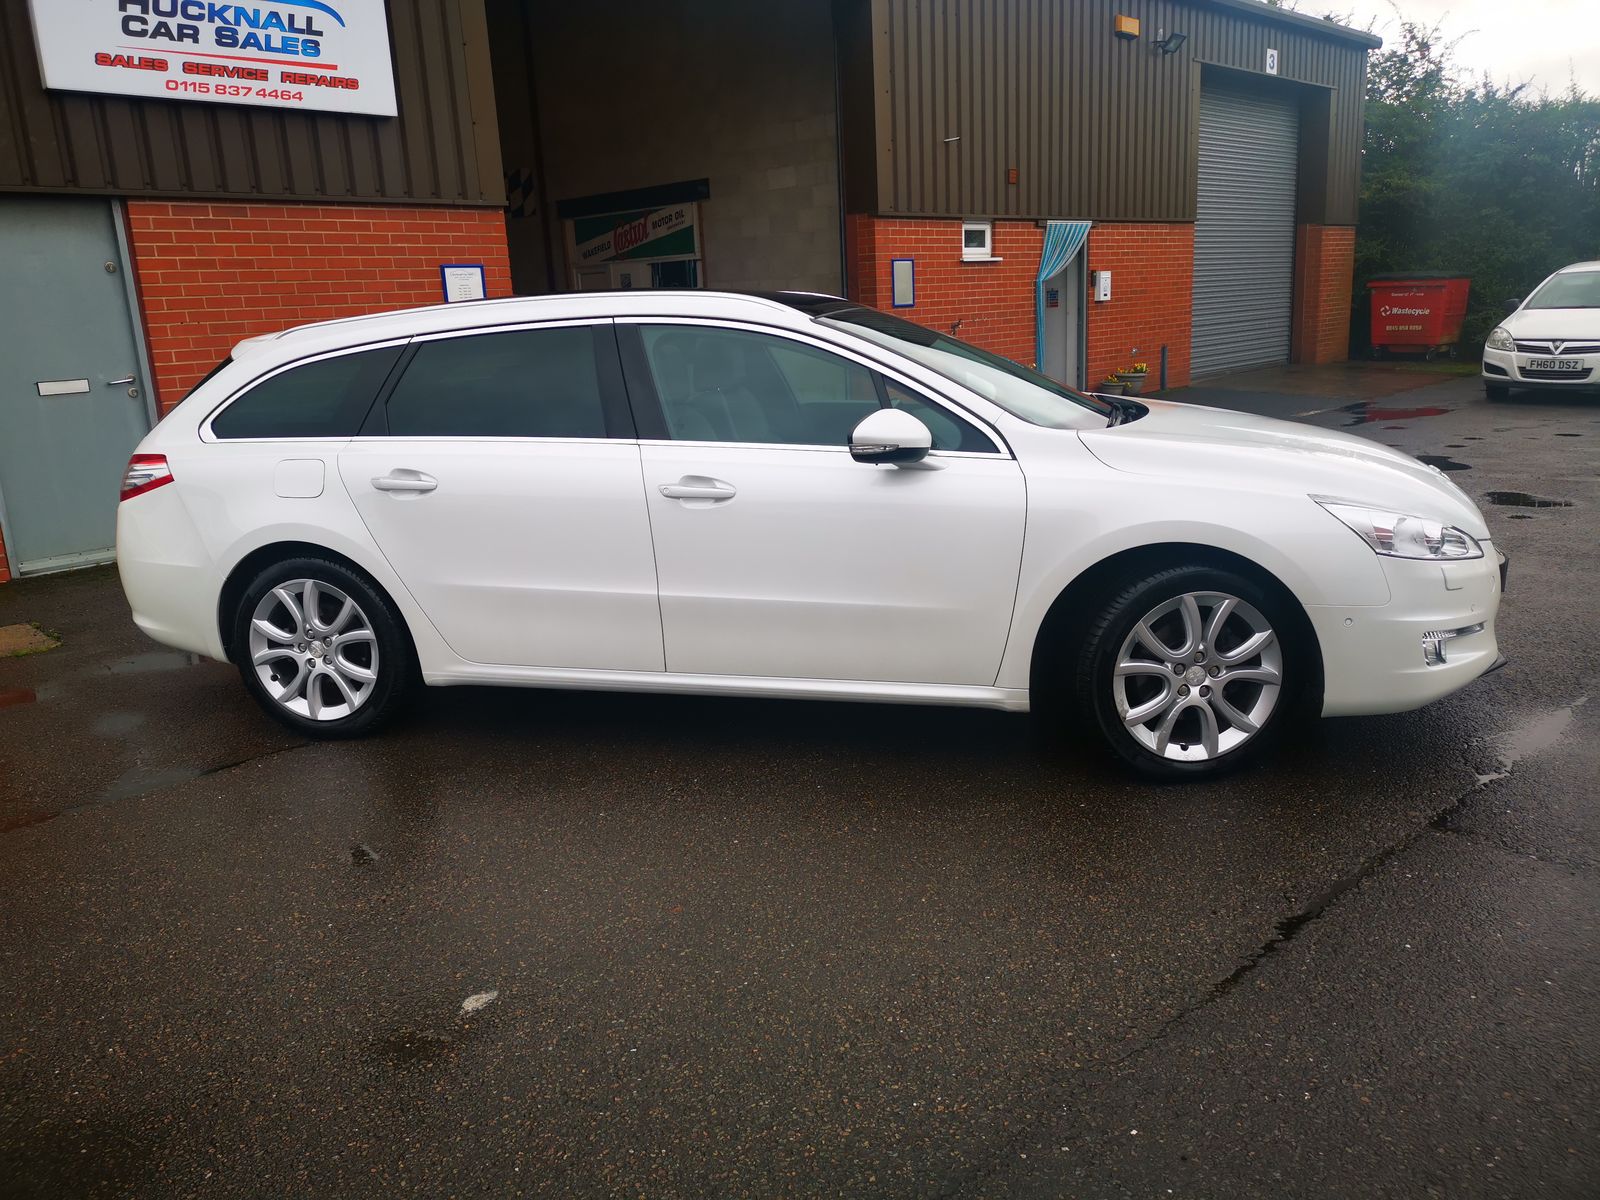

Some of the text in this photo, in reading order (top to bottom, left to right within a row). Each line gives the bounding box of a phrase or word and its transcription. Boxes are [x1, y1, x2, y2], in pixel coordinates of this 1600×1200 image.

[118, 0, 323, 37] HUCKNALL
[121, 15, 321, 58] CAR SALES
[94, 52, 359, 91] SALES SERVICE REPAIRS
[1269, 54, 1275, 70] 3
[165, 79, 304, 102] 0115 837 4464
[651, 213, 673, 229] MOTOR
[674, 208, 685, 221] OIL
[1529, 360, 1579, 370] FH60 DSZ
